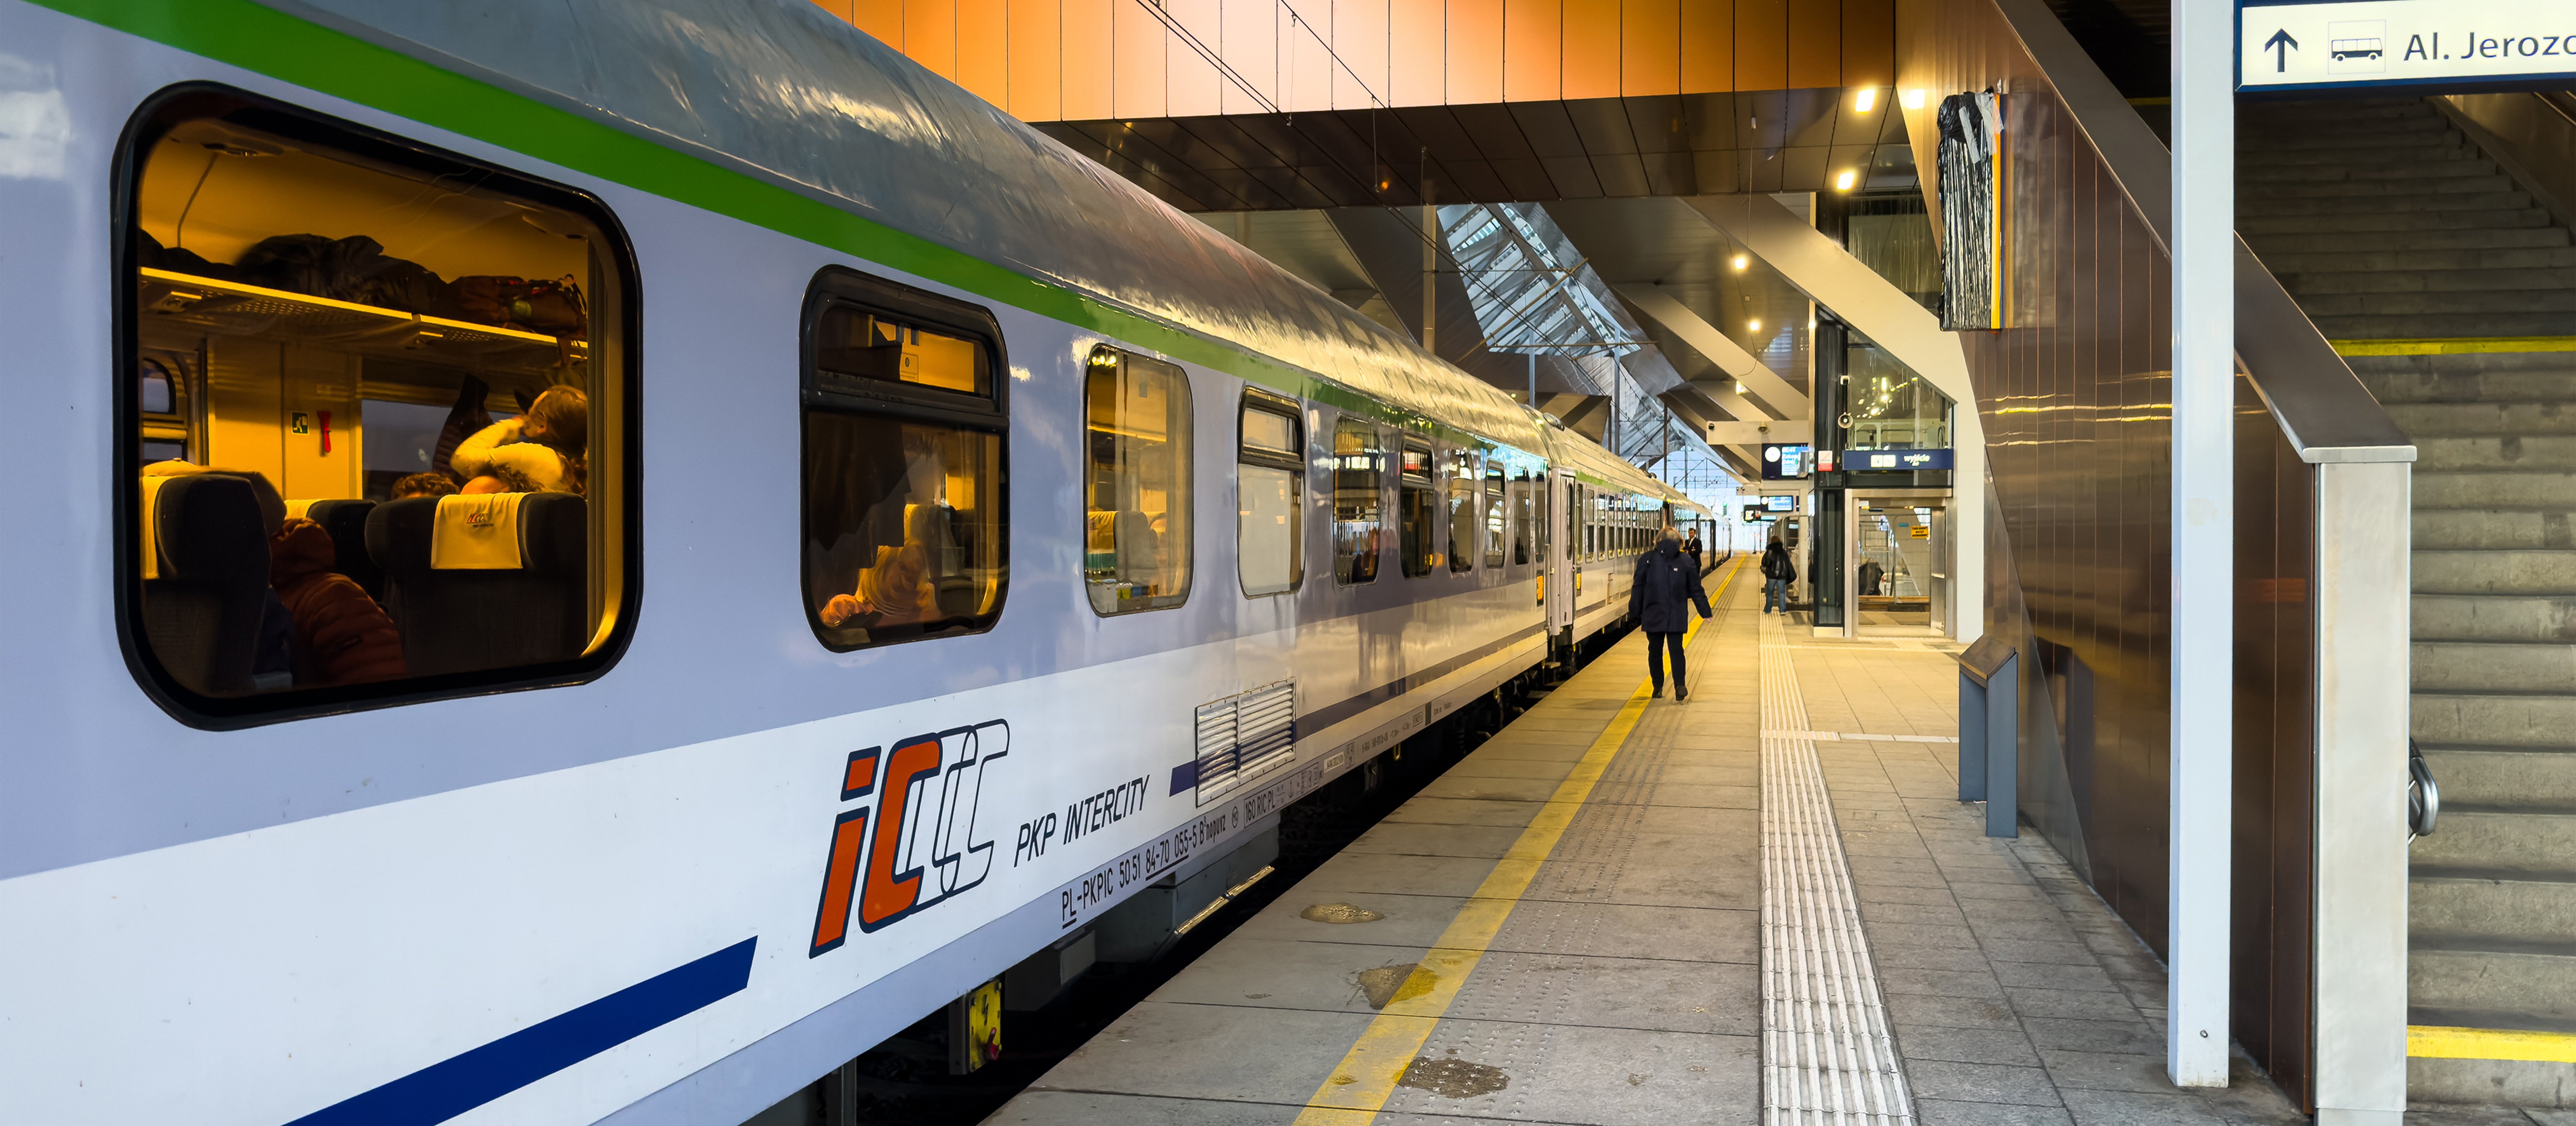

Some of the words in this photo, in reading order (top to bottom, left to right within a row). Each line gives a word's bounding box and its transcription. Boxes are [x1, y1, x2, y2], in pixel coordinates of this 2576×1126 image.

[2403, 32, 2450, 61] Al.
[1014, 812, 1056, 868] PKP
[1063, 775, 1150, 845] INTERCITY
[1246, 799, 1256, 823] 160
[1257, 793, 1266, 817] RIC
[1268, 789, 1275, 809] PL
[1146, 839, 1170, 874] 84-70
[1174, 825, 1197, 858] 055-5
